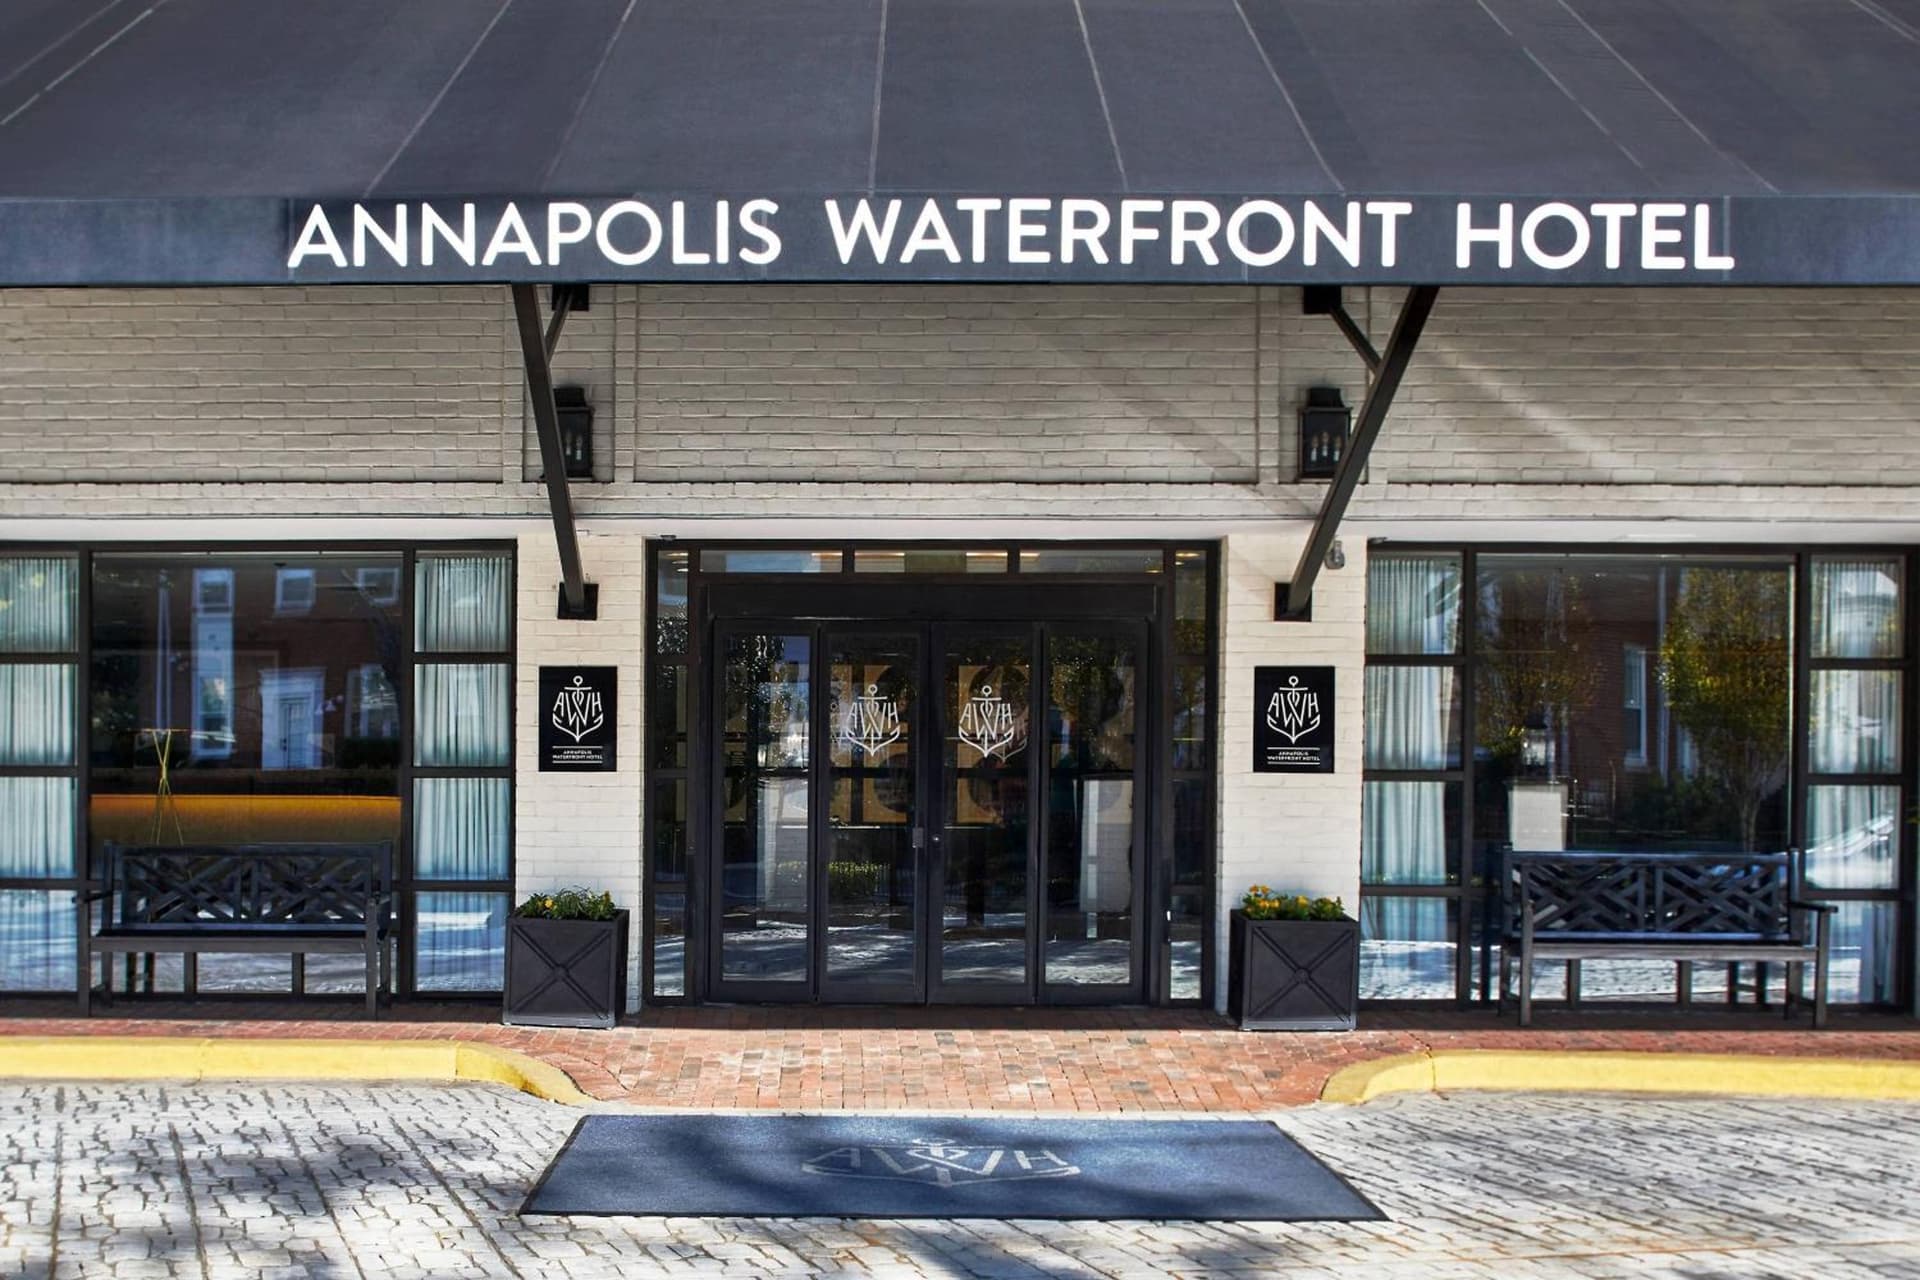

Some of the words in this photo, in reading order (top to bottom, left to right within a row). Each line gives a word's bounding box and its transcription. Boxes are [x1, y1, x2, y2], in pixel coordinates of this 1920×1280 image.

[287, 198, 782, 268] ANNAPOLIS
[824, 198, 1413, 268] WATERFRONT
[1456, 202, 1735, 270] HOTEL
